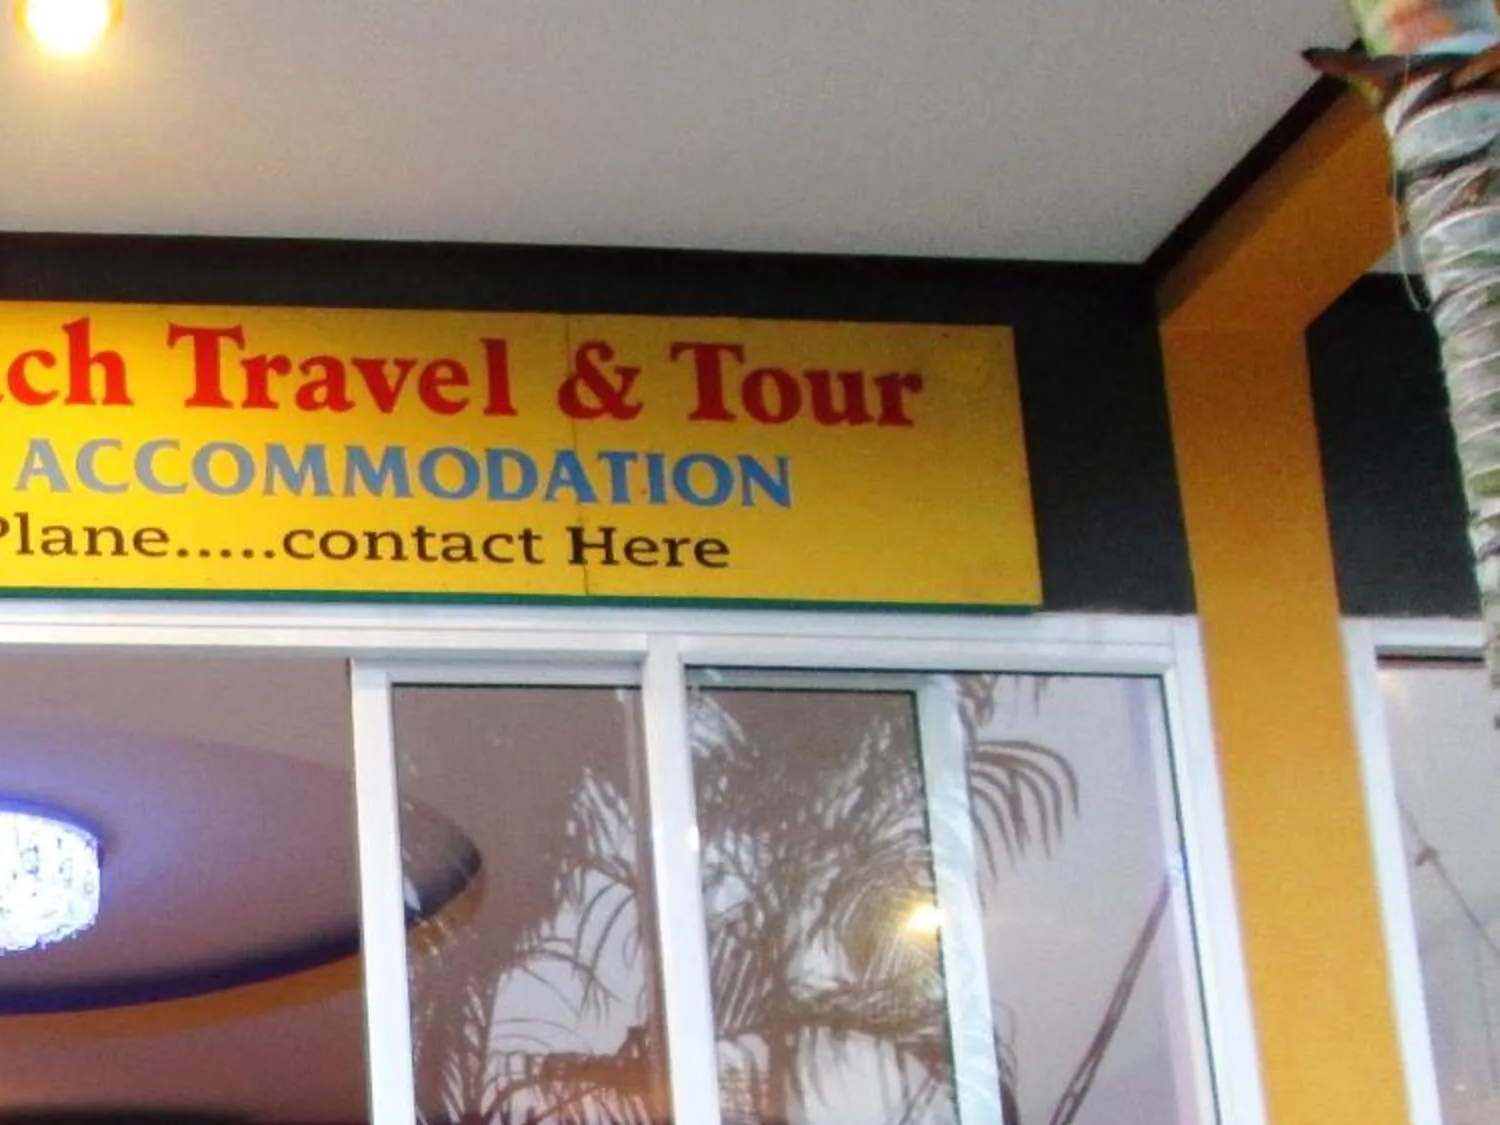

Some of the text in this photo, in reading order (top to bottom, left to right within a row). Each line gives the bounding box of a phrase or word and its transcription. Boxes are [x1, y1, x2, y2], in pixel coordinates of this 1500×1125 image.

[165, 322, 518, 419] Travel
[555, 339, 645, 424] &
[669, 340, 924, 430] Tour
[15, 437, 794, 510] ACCOMMODATION
[565, 524, 732, 570] Here
